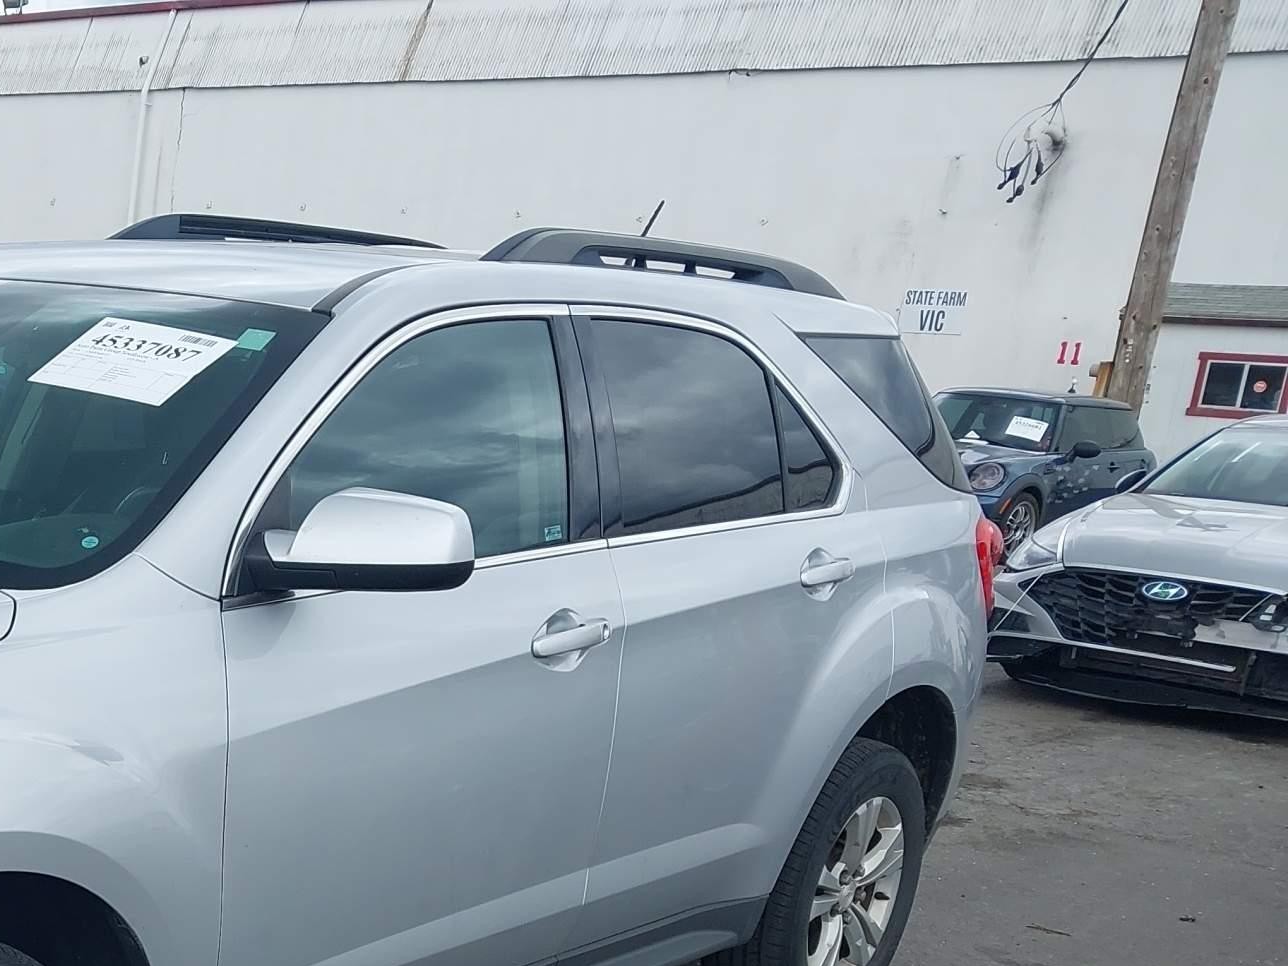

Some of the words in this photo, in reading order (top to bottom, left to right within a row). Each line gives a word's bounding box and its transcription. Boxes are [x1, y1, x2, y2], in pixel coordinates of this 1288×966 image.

[905, 290, 935, 306] STATE
[936, 291, 968, 307] FARM
[919, 309, 946, 332] VIC
[91, 334, 203, 362] 45337087
[1056, 341, 1082, 366] 11
